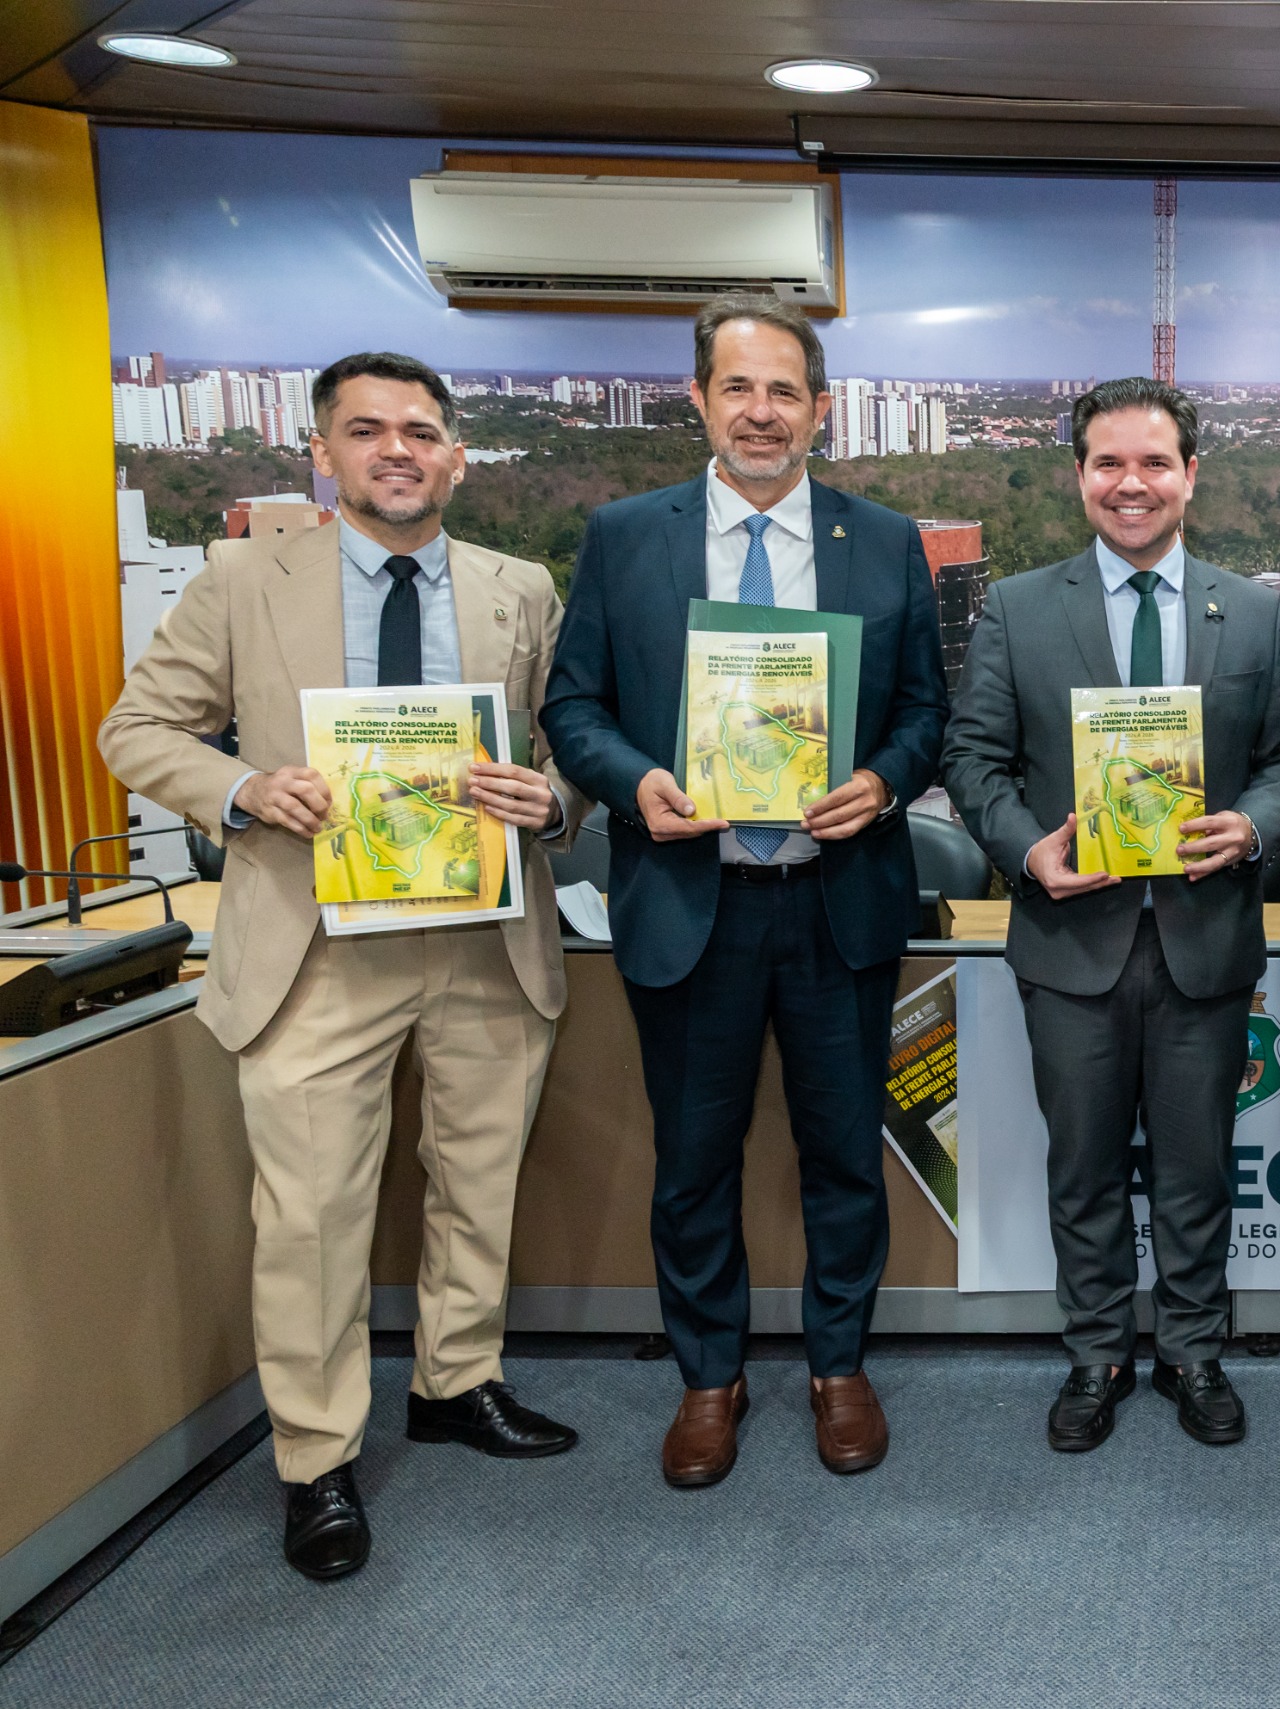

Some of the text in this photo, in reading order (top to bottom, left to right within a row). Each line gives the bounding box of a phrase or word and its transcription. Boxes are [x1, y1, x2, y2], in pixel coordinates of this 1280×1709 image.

[335, 720, 390, 728] RELATÓRIO
[398, 736, 458, 744] RENOVÁVEIS
[891, 1010, 924, 1037] ALECE
[888, 1020, 957, 1070] LIVRO DIGITAL
[886, 1060, 927, 1092] RELATÓRIO
[892, 1088, 907, 1102] DA
[904, 1070, 933, 1093] FRENTE
[900, 1075, 948, 1111] DE ENERGIAS
[934, 1084, 956, 1104] 2024 A
[1248, 1244, 1276, 1258] DO
